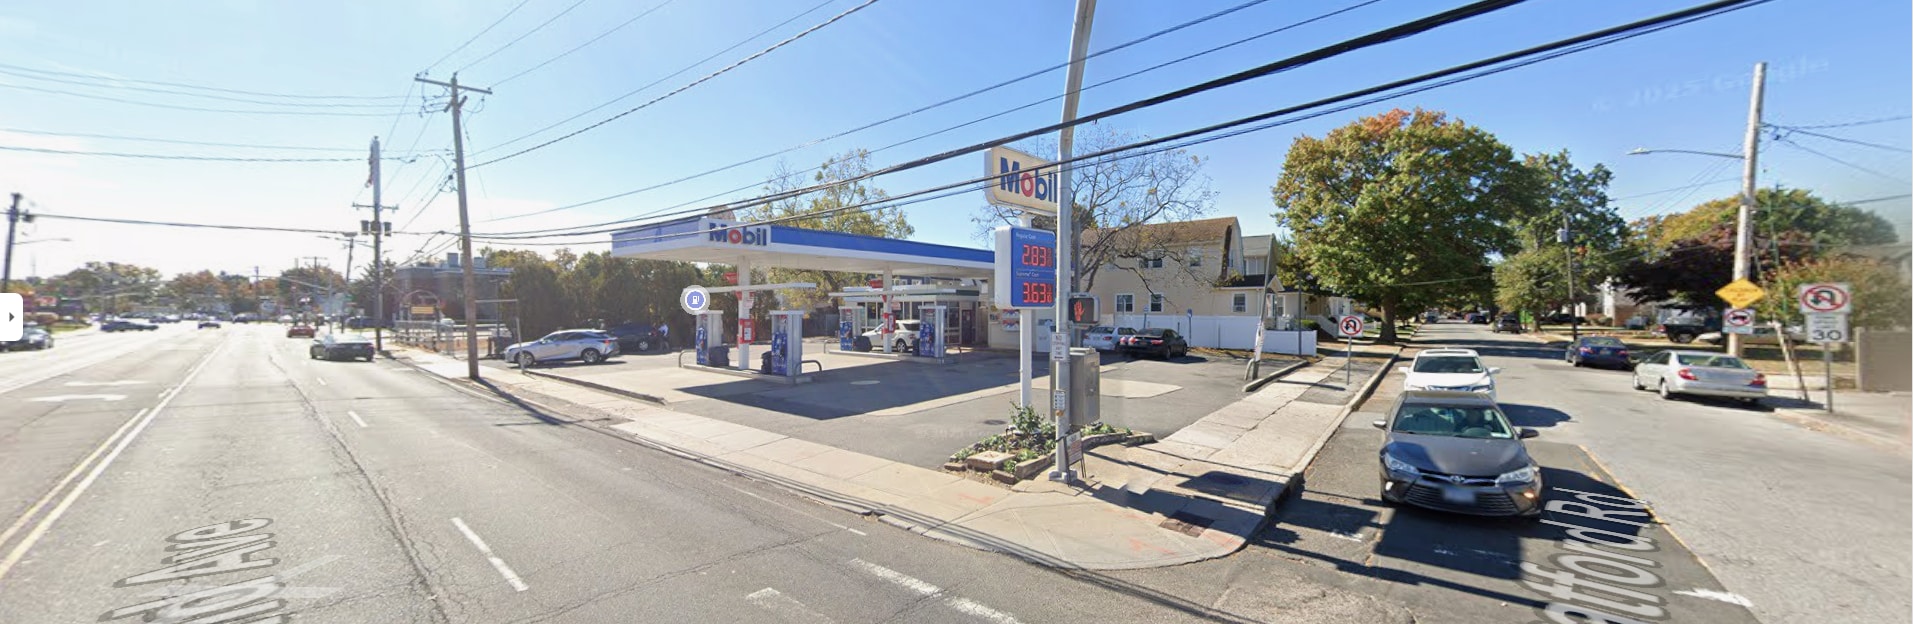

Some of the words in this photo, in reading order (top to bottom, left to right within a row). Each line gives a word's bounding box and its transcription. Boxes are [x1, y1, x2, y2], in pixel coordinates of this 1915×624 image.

[1000, 157, 1058, 203] Mobil
[708, 222, 767, 246] Mobil
[1812, 329, 1842, 341] 30
